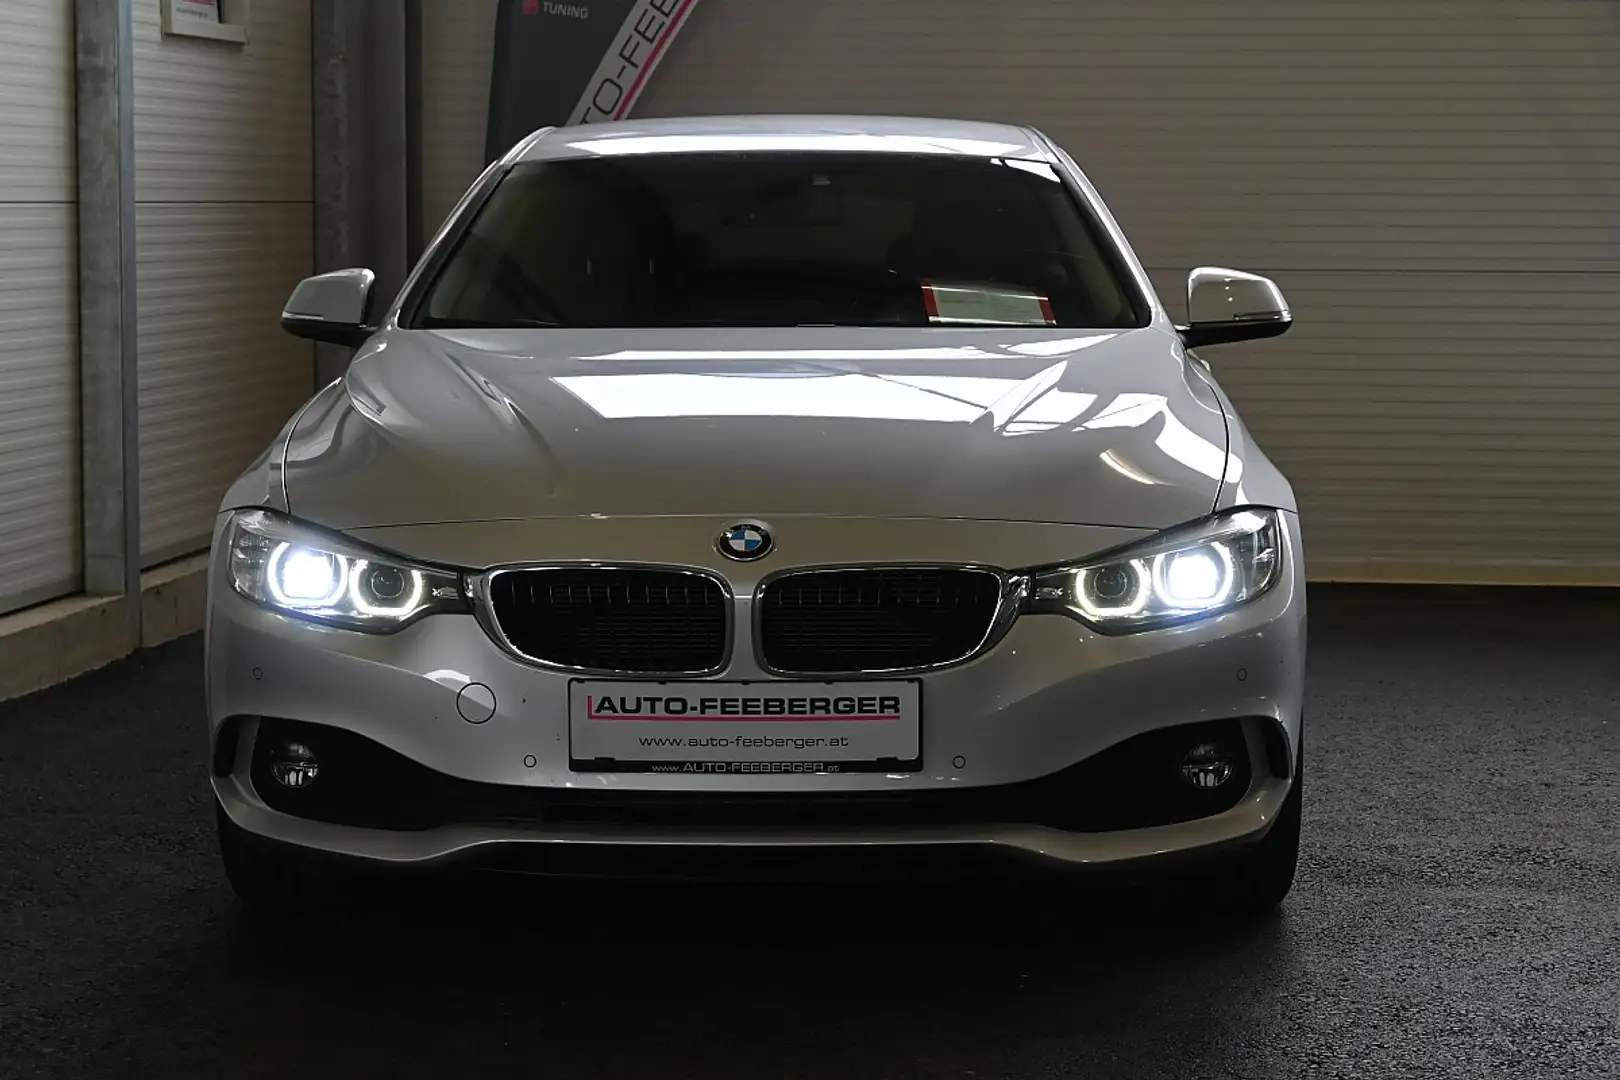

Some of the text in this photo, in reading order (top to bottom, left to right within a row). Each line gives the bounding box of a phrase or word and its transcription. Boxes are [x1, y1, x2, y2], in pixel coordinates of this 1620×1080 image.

[543, 2, 589, 19] TUNING
[595, 696, 900, 715] AUTO-FEEBERGER
[639, 735, 849, 749] www.auto-feeberger.at
[652, 762, 840, 773] www.AUTO-FEEBERGER.at
